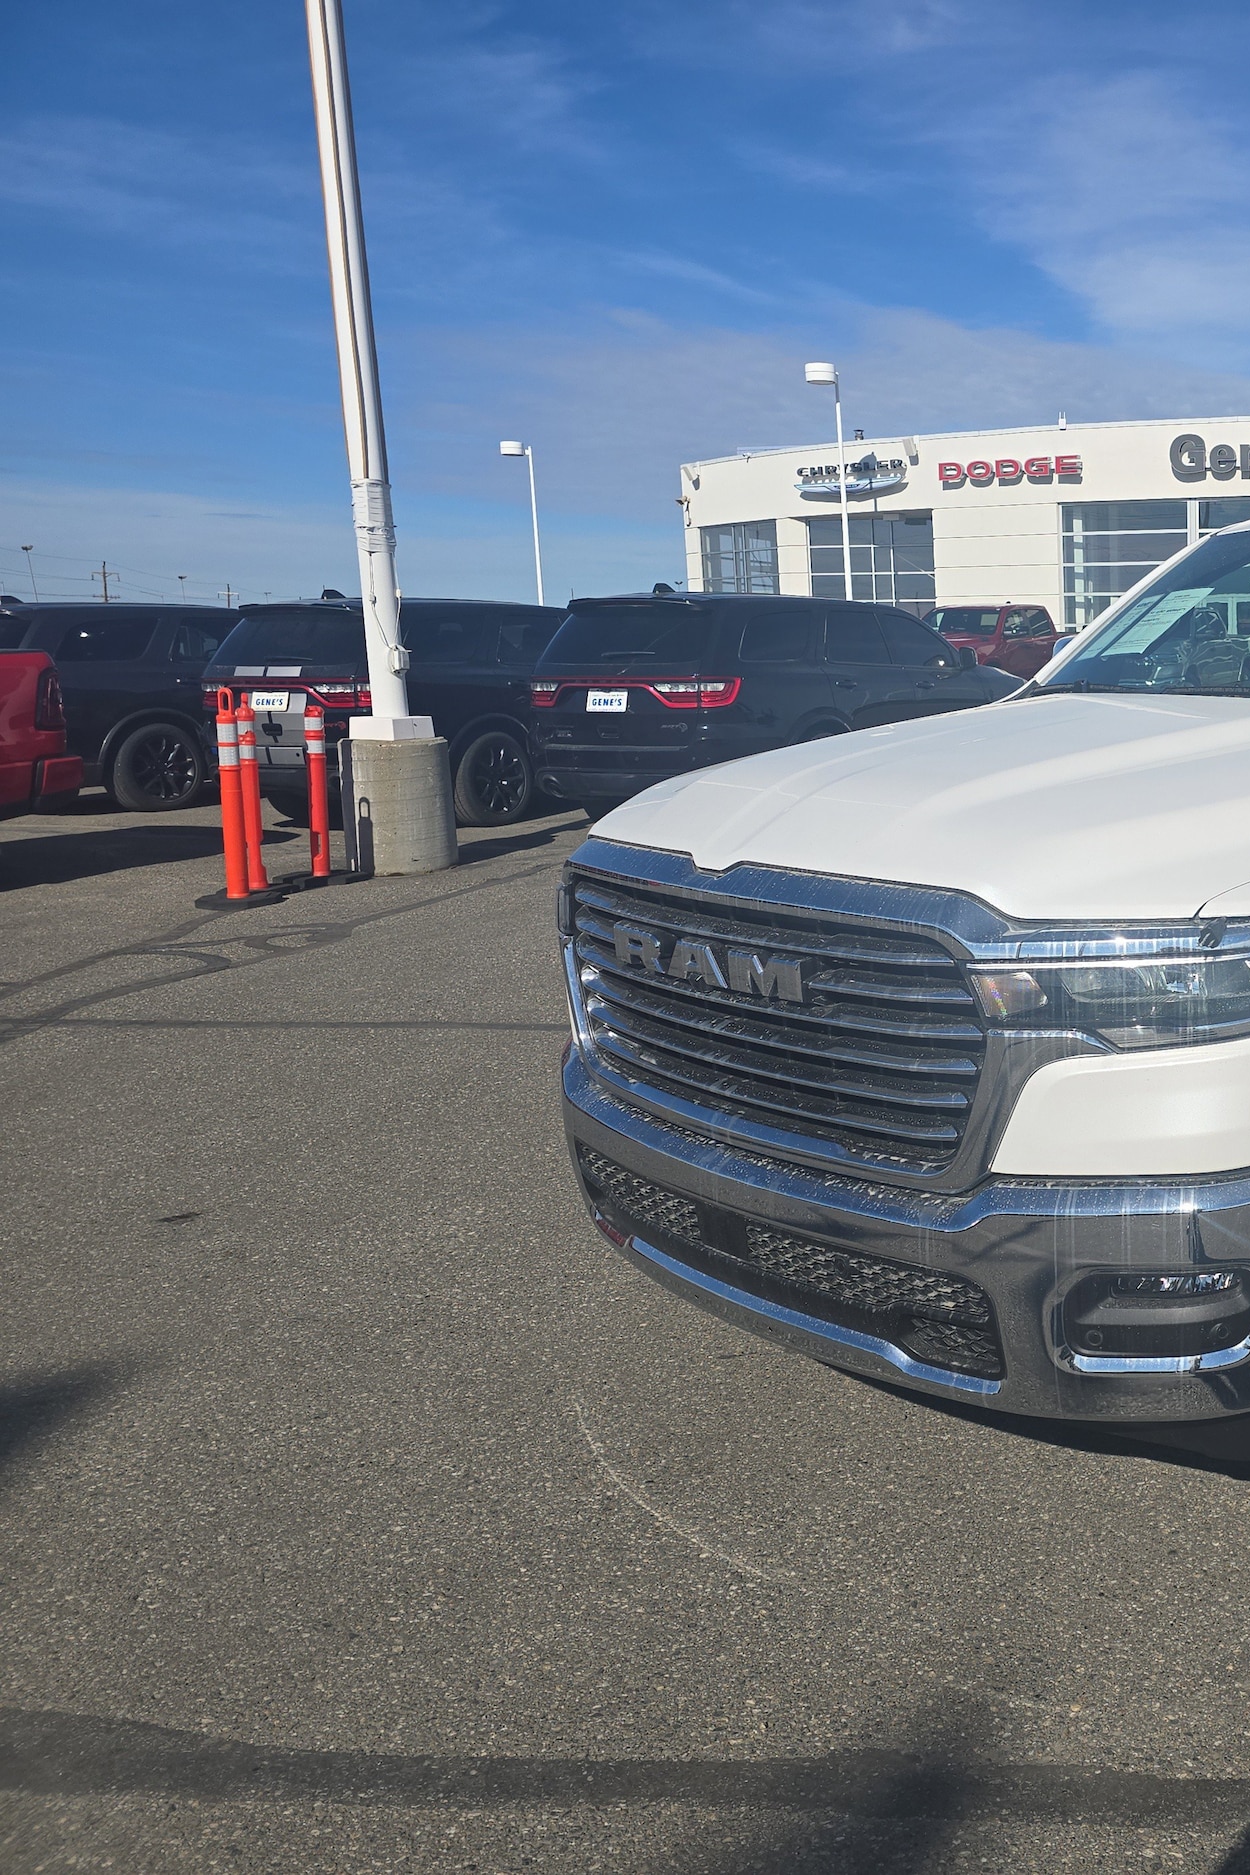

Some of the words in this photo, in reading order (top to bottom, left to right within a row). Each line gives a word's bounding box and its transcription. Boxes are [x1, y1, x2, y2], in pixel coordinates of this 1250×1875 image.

[938, 454, 1082, 481] DODGE
[255, 698, 284, 706] GENE'S
[592, 698, 623, 706] GENE'S
[613, 920, 804, 1002] RAM
